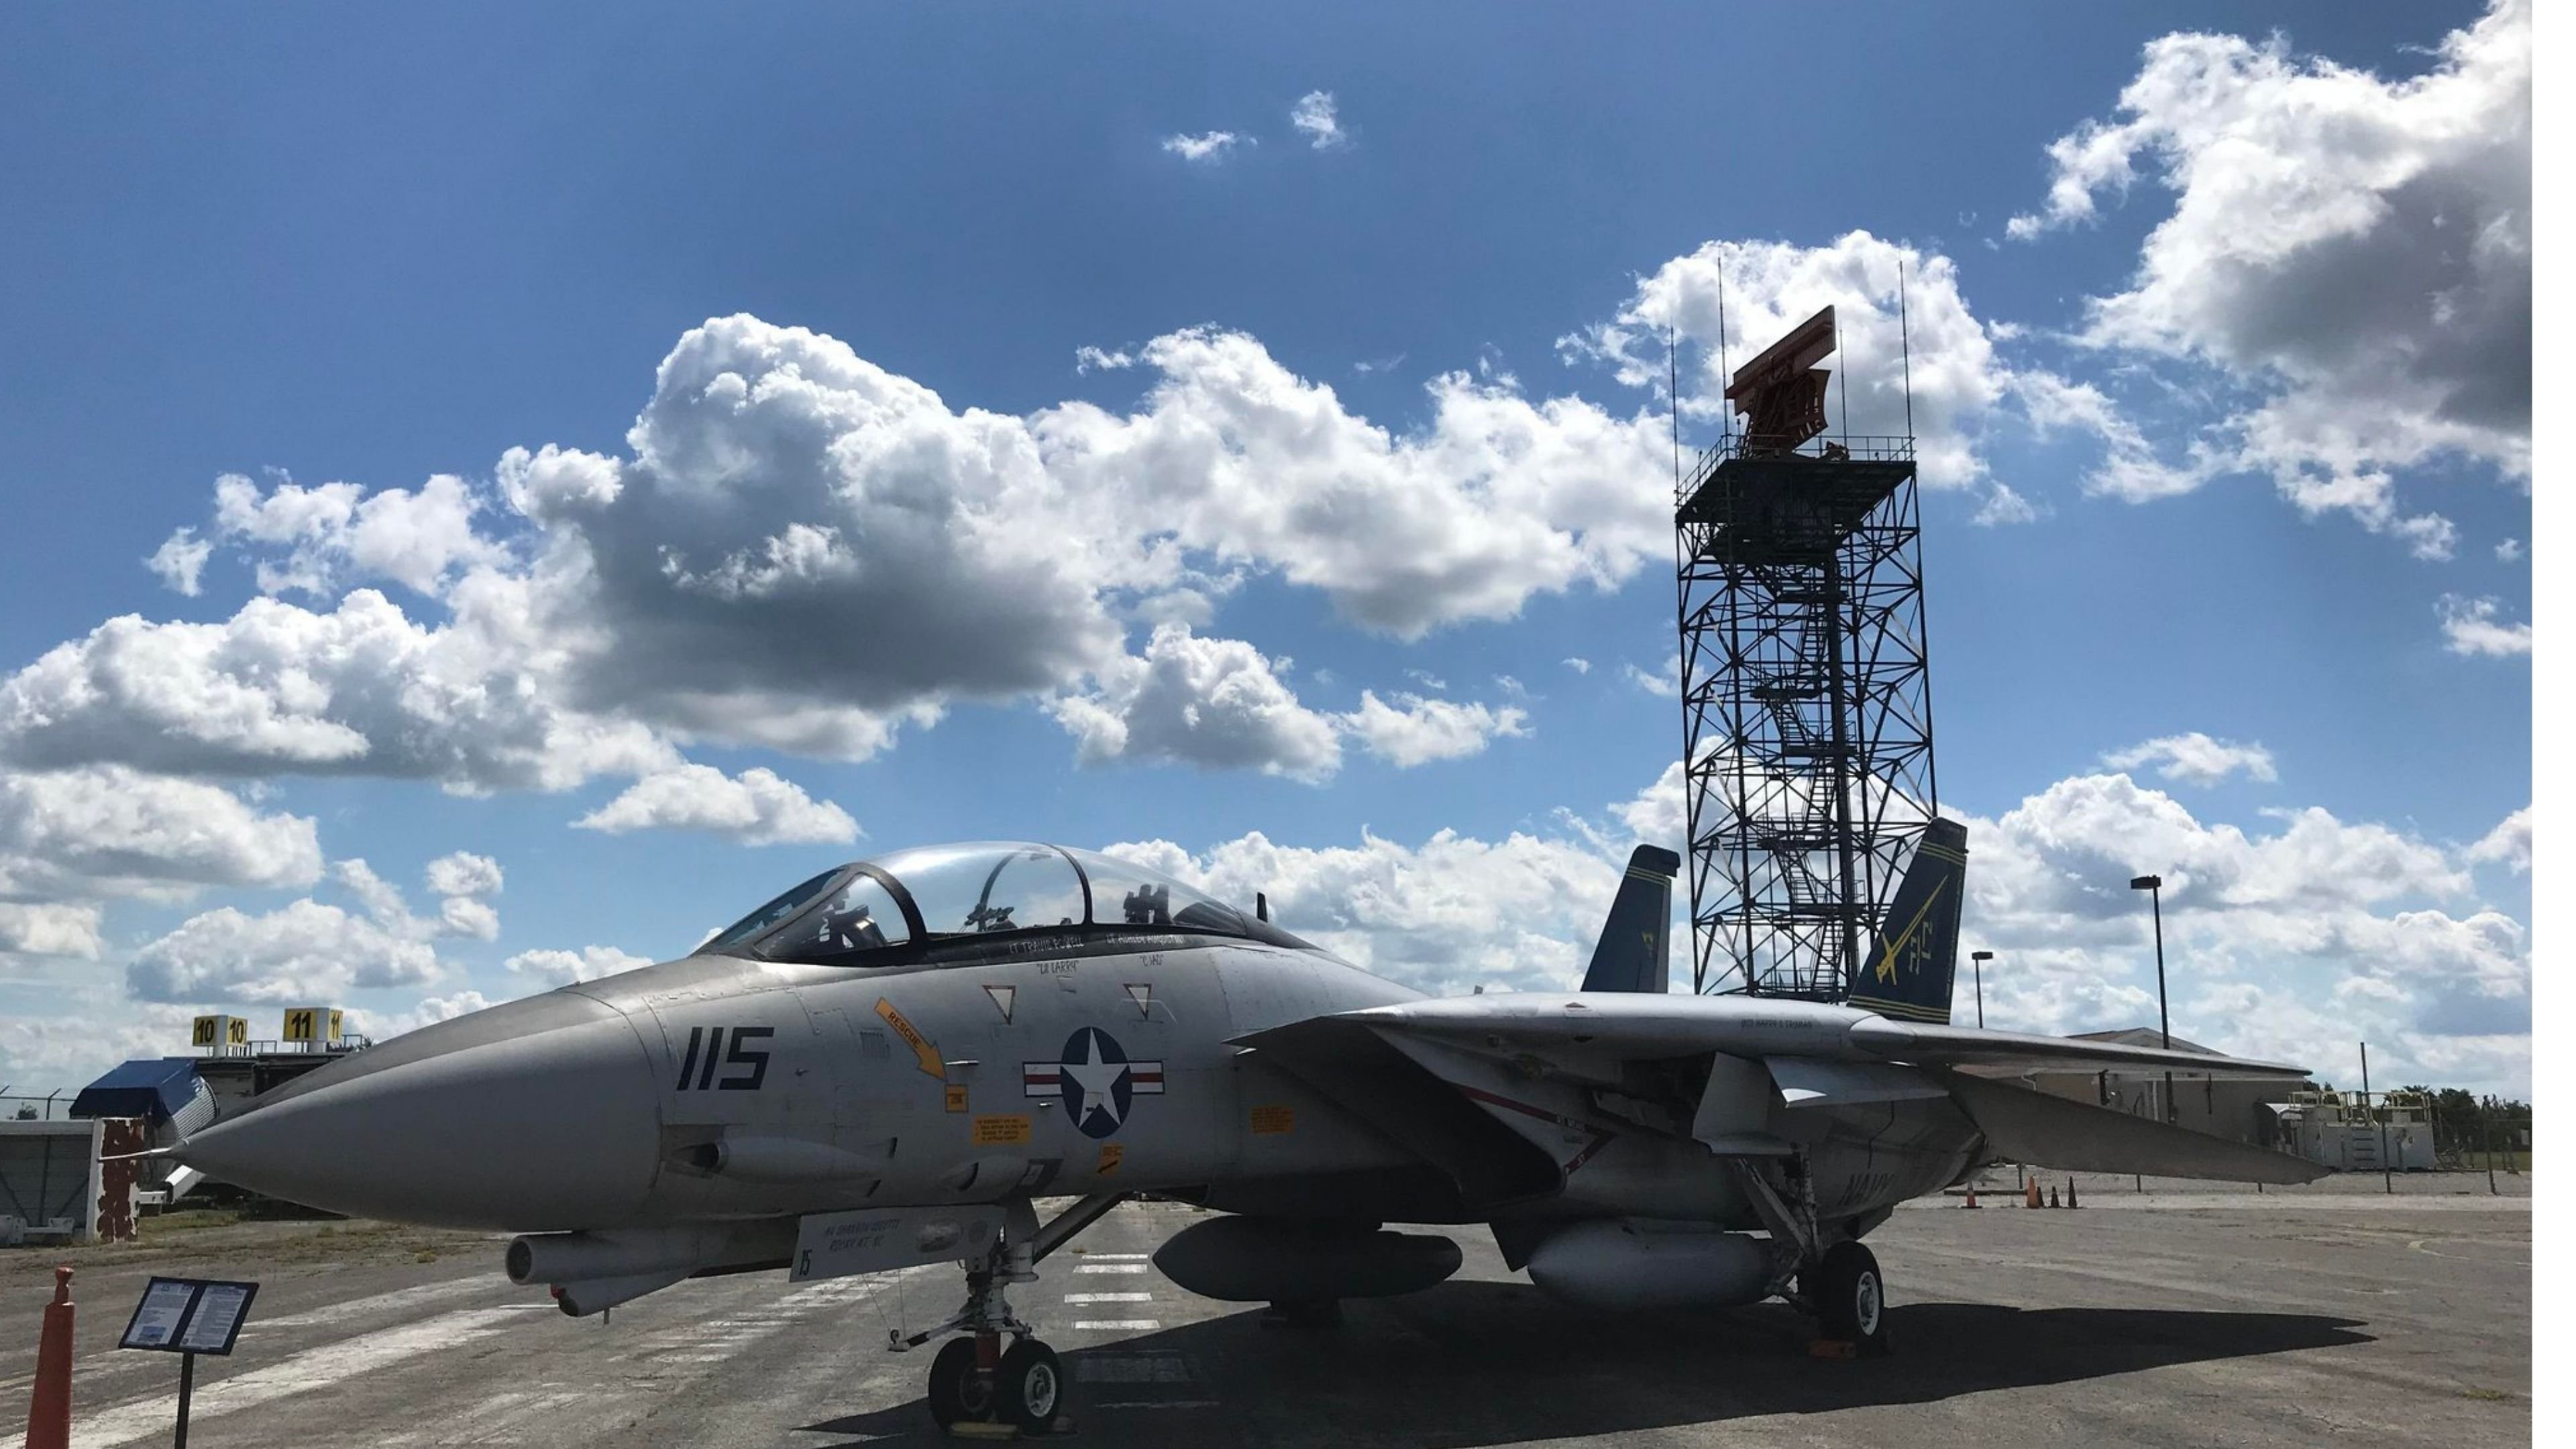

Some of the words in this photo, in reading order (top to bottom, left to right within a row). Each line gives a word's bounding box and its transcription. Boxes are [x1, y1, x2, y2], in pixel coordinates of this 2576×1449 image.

[197, 1019, 215, 1042] 10
[229, 1020, 244, 1042] 10
[290, 1012, 311, 1038] 11
[331, 1014, 340, 1038] 11
[888, 1010, 922, 1049] RESCUE
[676, 1026, 775, 1091] 115
[799, 1248, 813, 1276] 15
